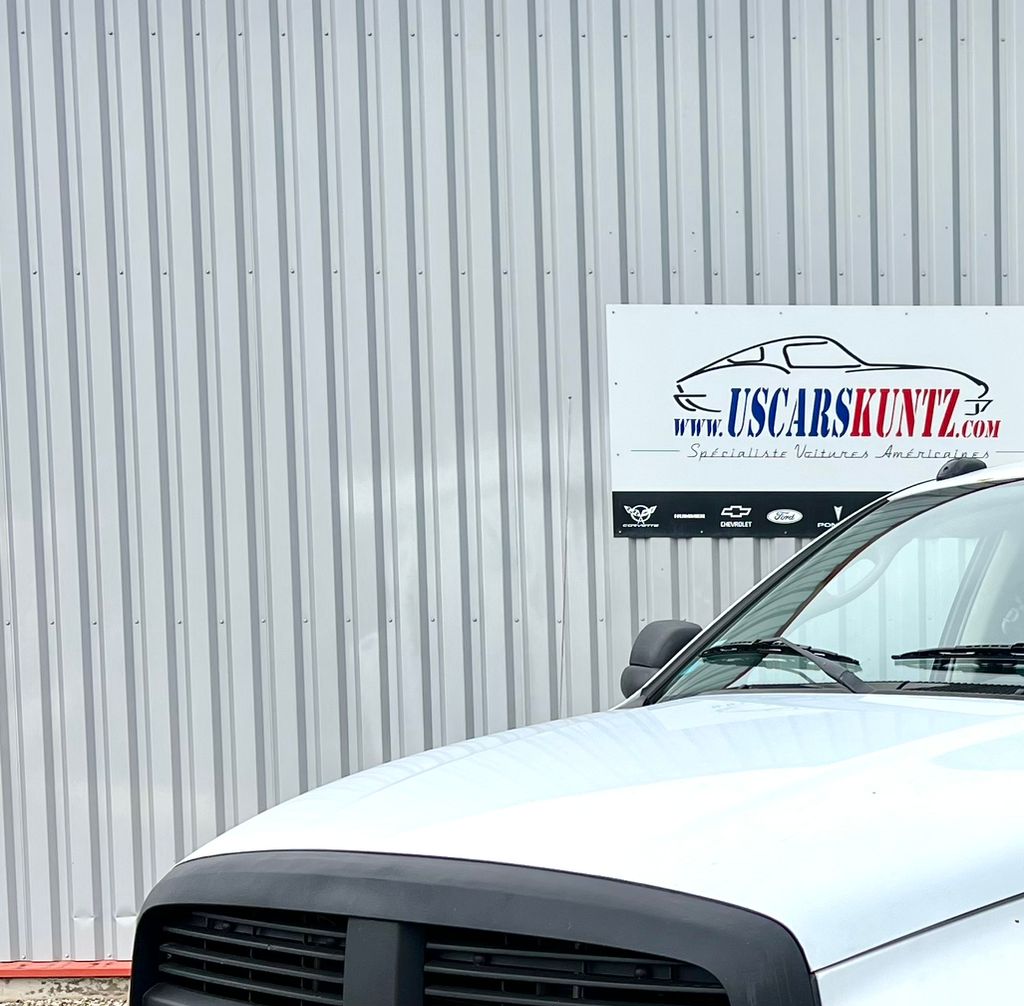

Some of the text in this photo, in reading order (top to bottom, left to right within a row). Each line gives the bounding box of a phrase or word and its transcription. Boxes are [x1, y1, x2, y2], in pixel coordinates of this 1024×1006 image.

[687, 442, 788, 462] Spécialiste
[794, 443, 869, 460] Voitures
[774, 511, 795, 521] Ford
